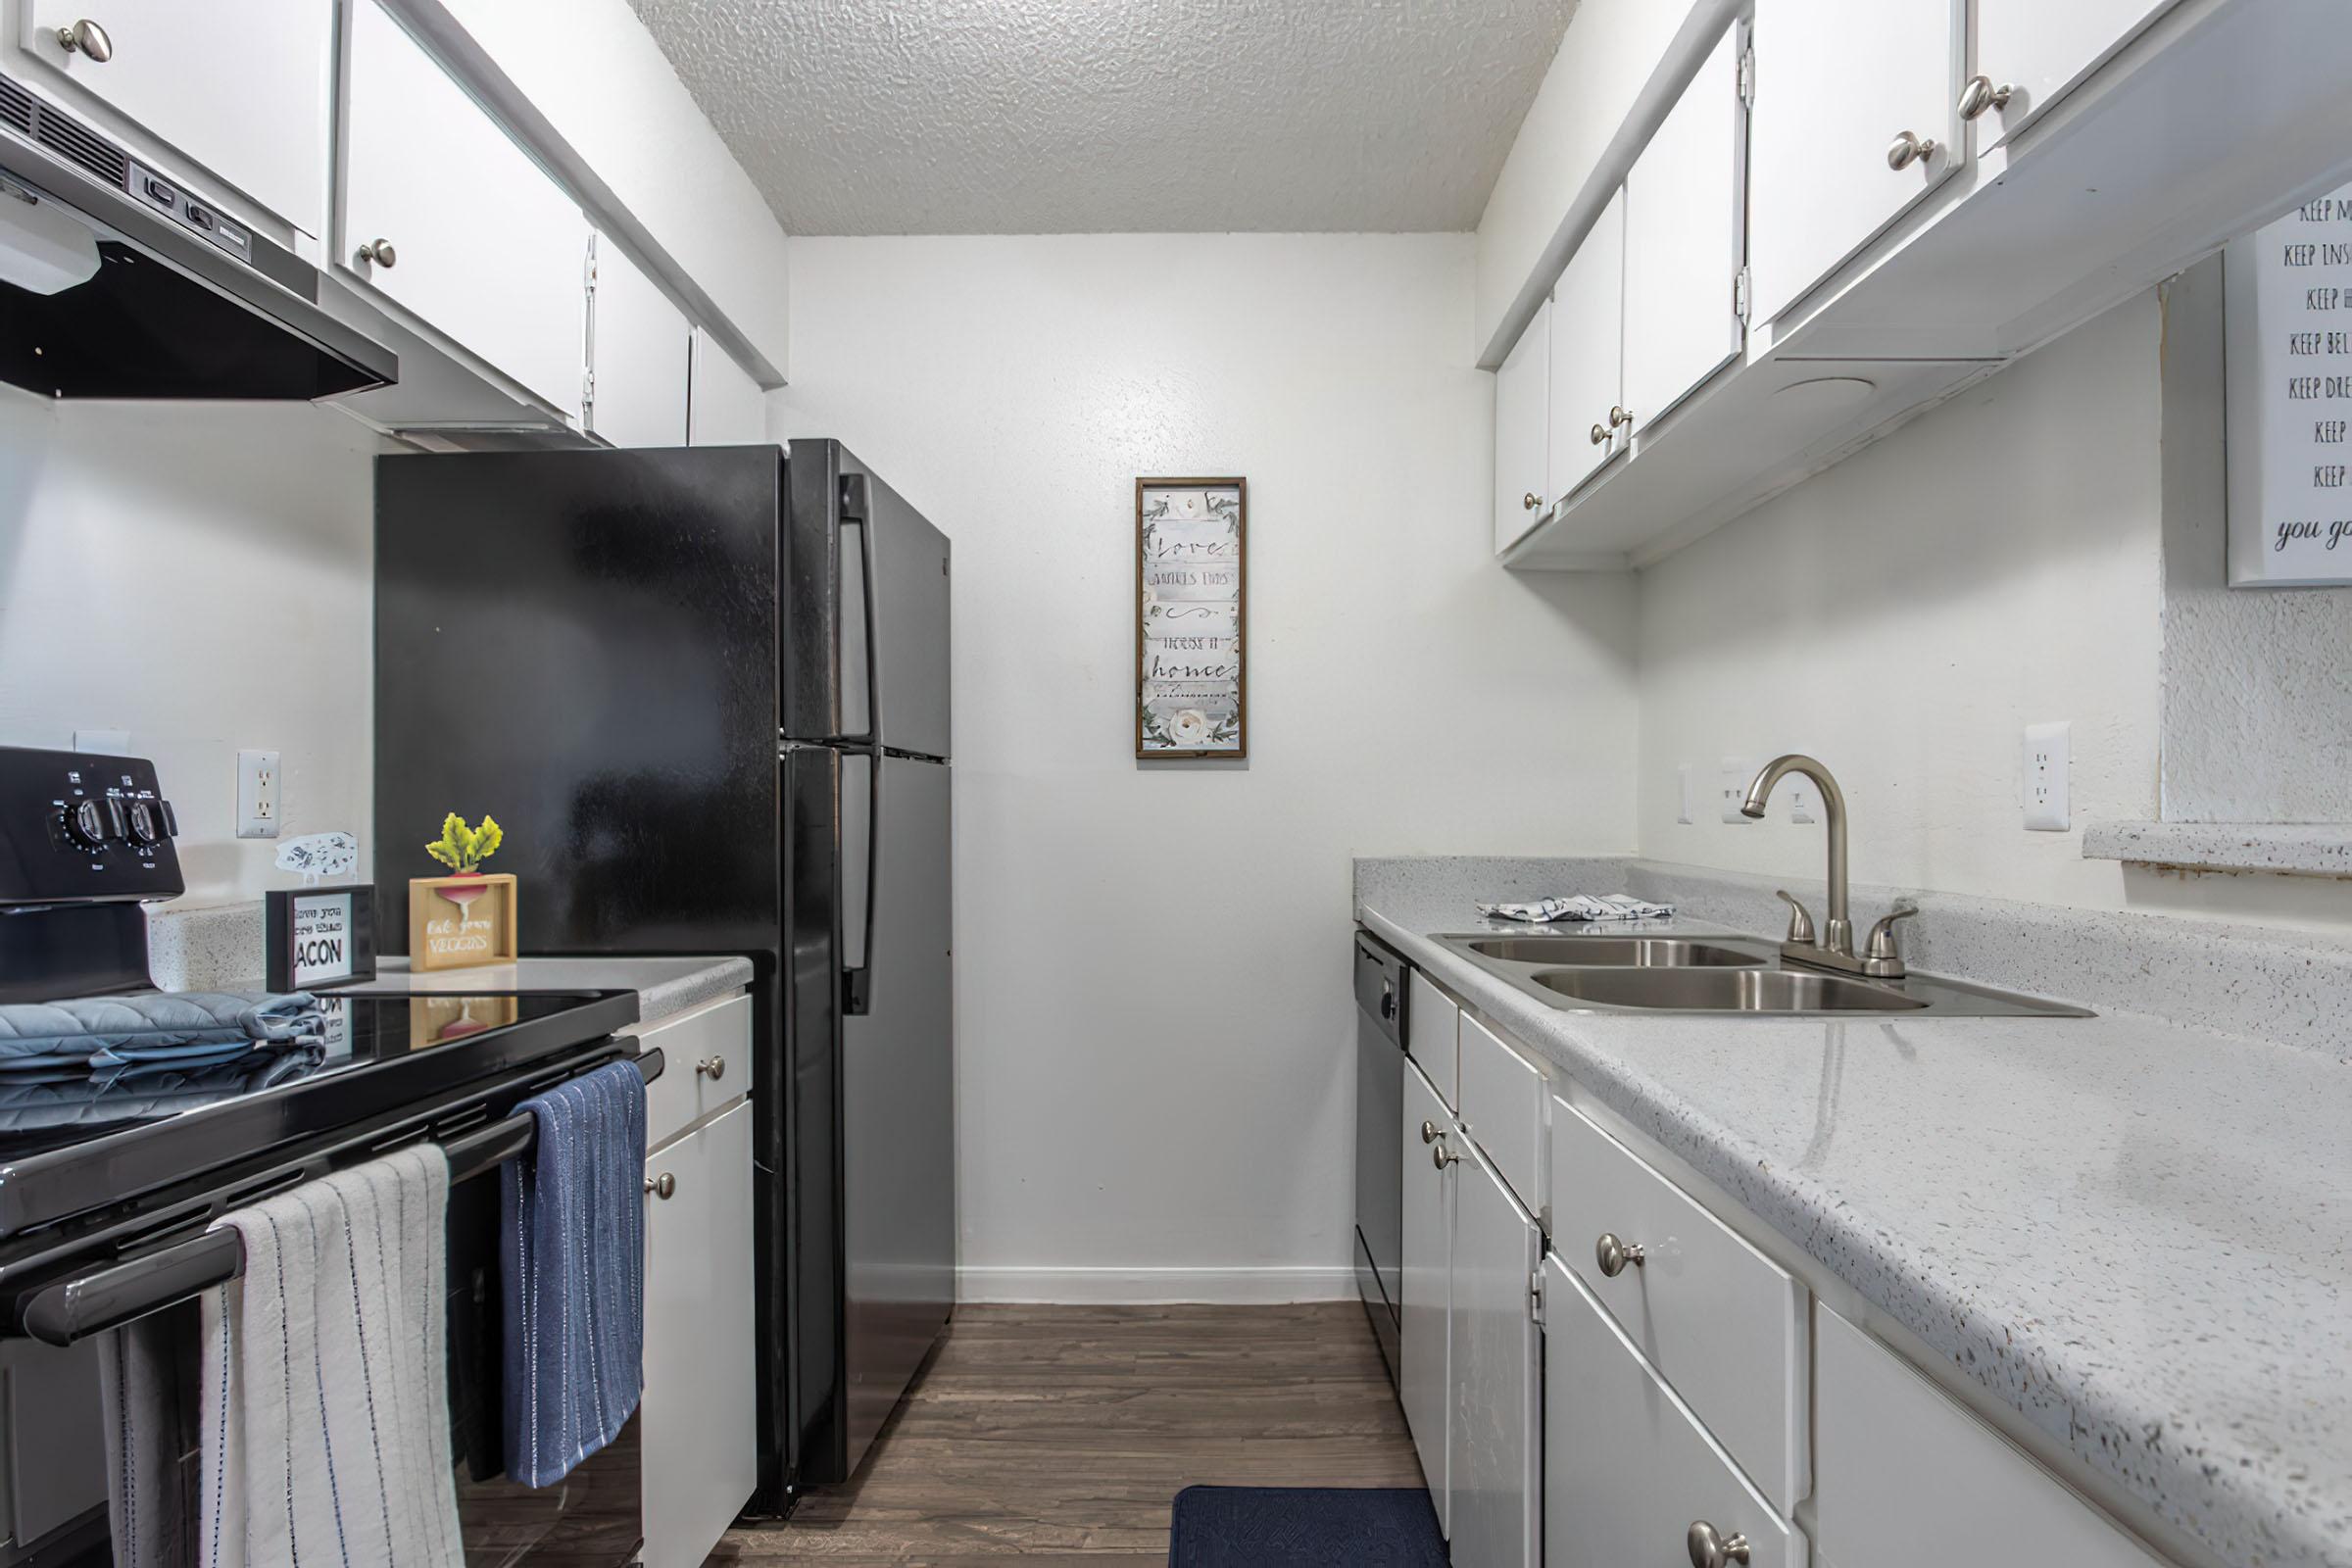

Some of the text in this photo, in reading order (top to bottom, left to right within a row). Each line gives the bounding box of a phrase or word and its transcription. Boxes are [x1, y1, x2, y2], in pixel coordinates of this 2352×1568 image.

[2300, 200, 2331, 221] KEEP
[2284, 244, 2316, 267] KEEP
[2306, 288, 2338, 310] KEEP
[2290, 333, 2321, 355] KEEP
[2289, 377, 2321, 399] KEEP
[2315, 420, 2346, 443] KEEP
[2314, 466, 2345, 487] KEEP
[2275, 521, 2322, 552] you
[1152, 655, 1236, 678] home
[294, 939, 342, 967] ACON
